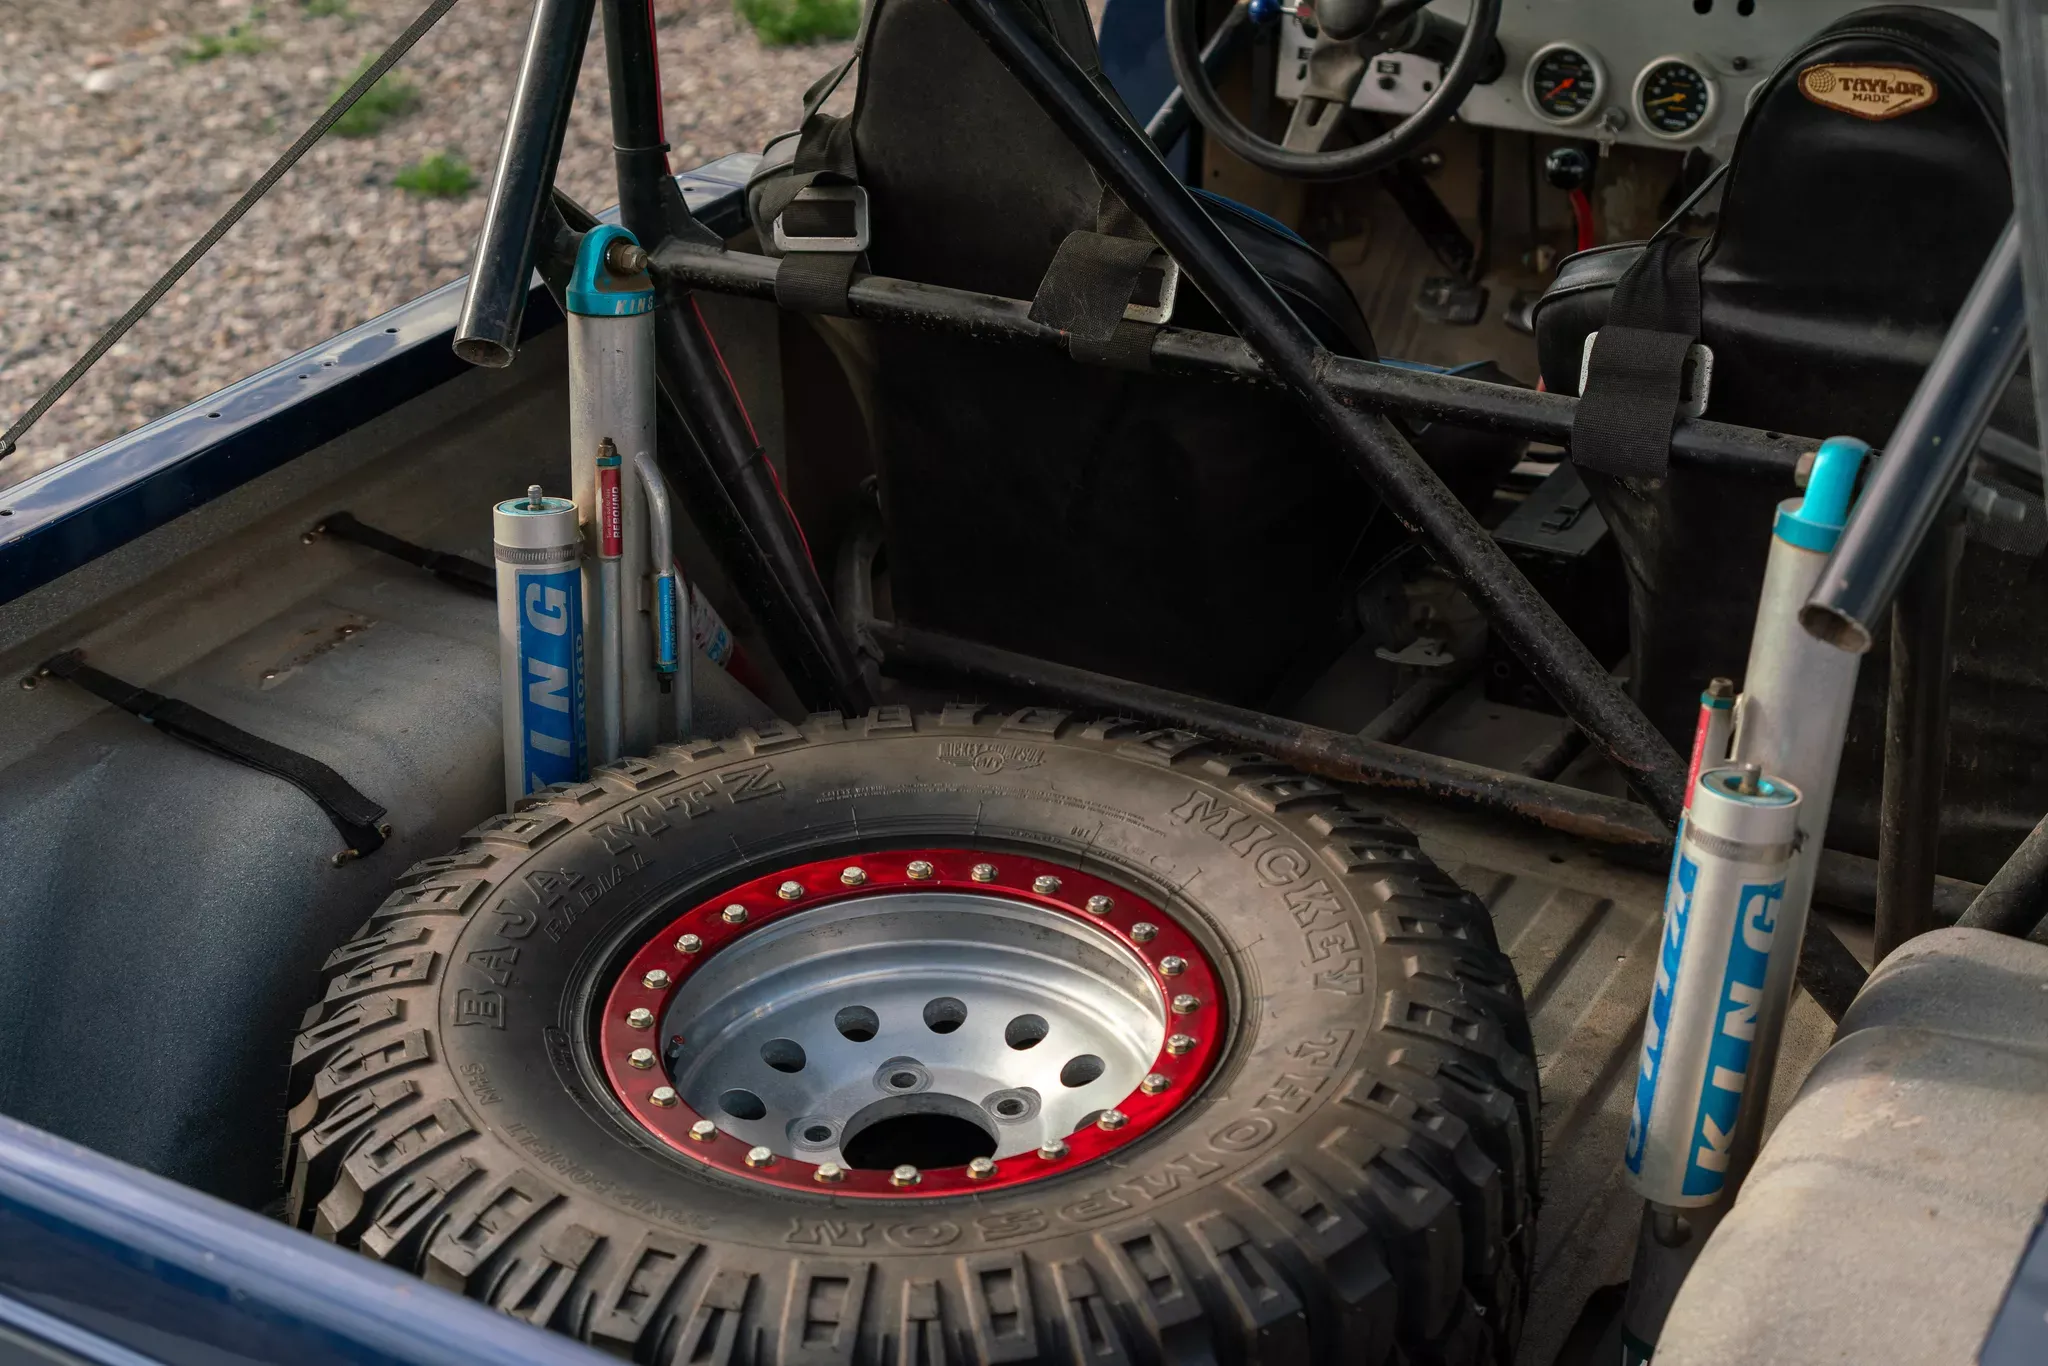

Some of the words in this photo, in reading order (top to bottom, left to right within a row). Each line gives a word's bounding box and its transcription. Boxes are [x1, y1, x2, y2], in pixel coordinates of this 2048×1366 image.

[1838, 77, 1925, 97] TAYLOR
[1852, 93, 1890, 103] MADE
[612, 486, 621, 539] REBOUND
[453, 867, 584, 1031] BAJA
[588, 762, 786, 856] MTZ
[543, 852, 654, 943] RADIAL
[1169, 789, 1364, 997] MICKEY
[1695, 893, 1782, 1174] KING
[458, 1062, 503, 1107] M+S
[784, 1027, 1357, 1249] THOMPSON
